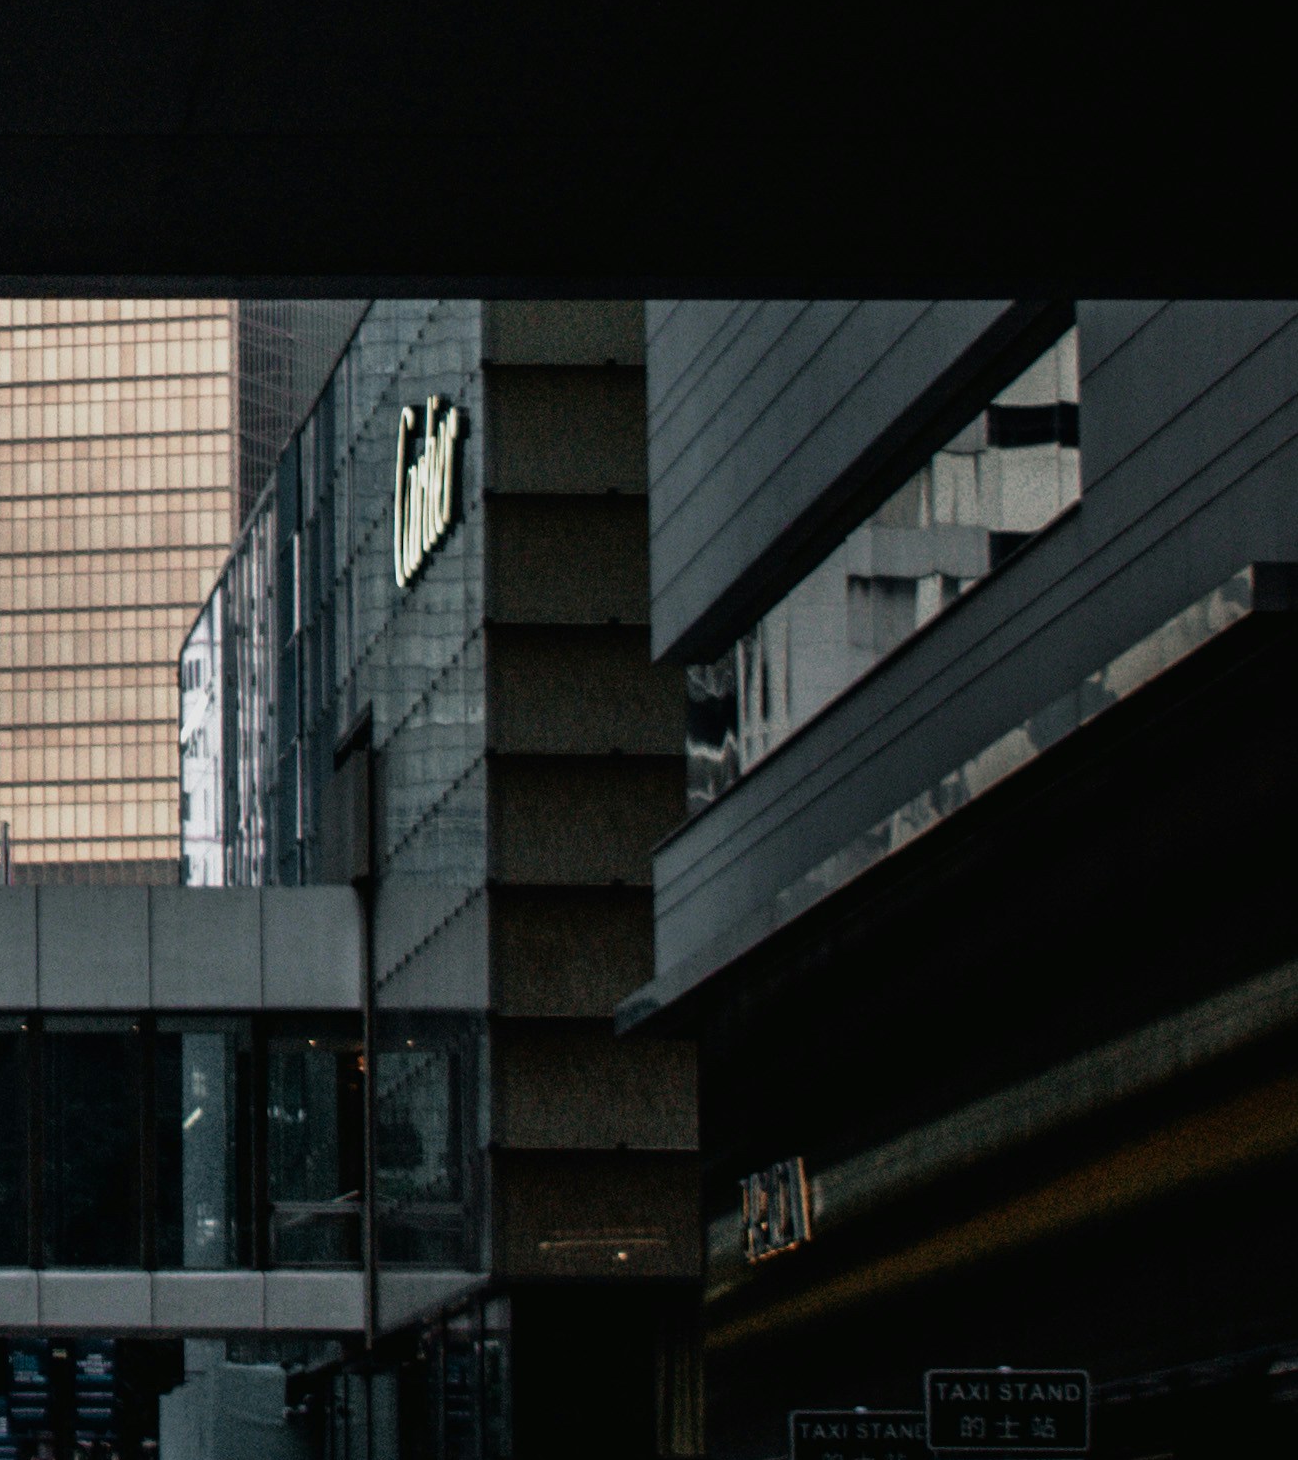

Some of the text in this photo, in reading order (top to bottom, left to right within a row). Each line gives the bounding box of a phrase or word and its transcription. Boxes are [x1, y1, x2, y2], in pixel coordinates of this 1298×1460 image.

[394, 394, 459, 588] Cartier
[934, 1381, 1082, 1402] TAXI STAND
[800, 1421, 848, 1440] TAXI
[959, 1414, 1058, 1439] 的士站
